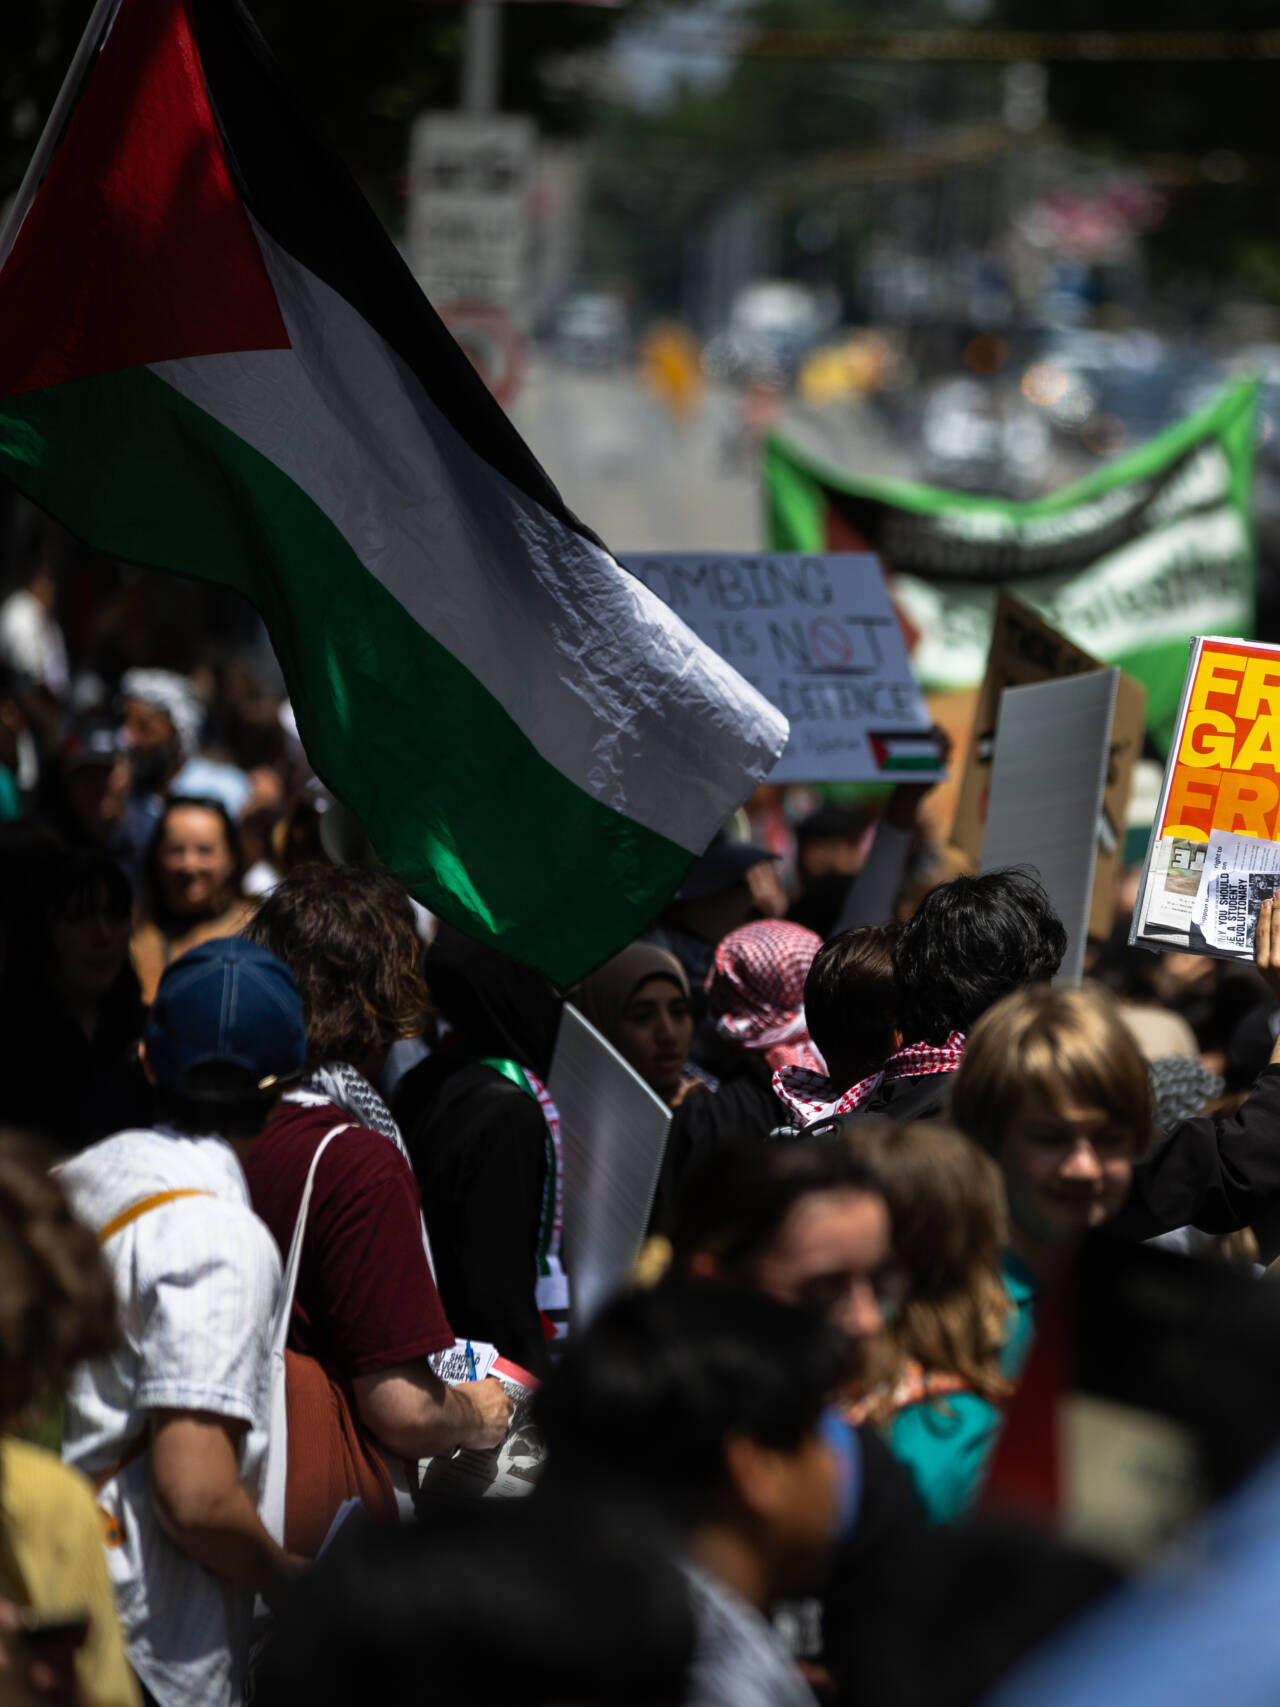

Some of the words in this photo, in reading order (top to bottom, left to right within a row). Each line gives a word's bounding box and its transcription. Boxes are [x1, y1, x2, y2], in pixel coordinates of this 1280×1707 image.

[641, 557, 833, 612] OMBING
[713, 620, 757, 656] IS
[768, 614, 893, 668] NOT
[1220, 873, 1229, 905] SHOULD
[1228, 884, 1238, 922] STUDENT
[1218, 907, 1228, 926] YOU
[1236, 879, 1248, 947] REVOLUTIONARY
[450, 1352, 481, 1366] SHOD
